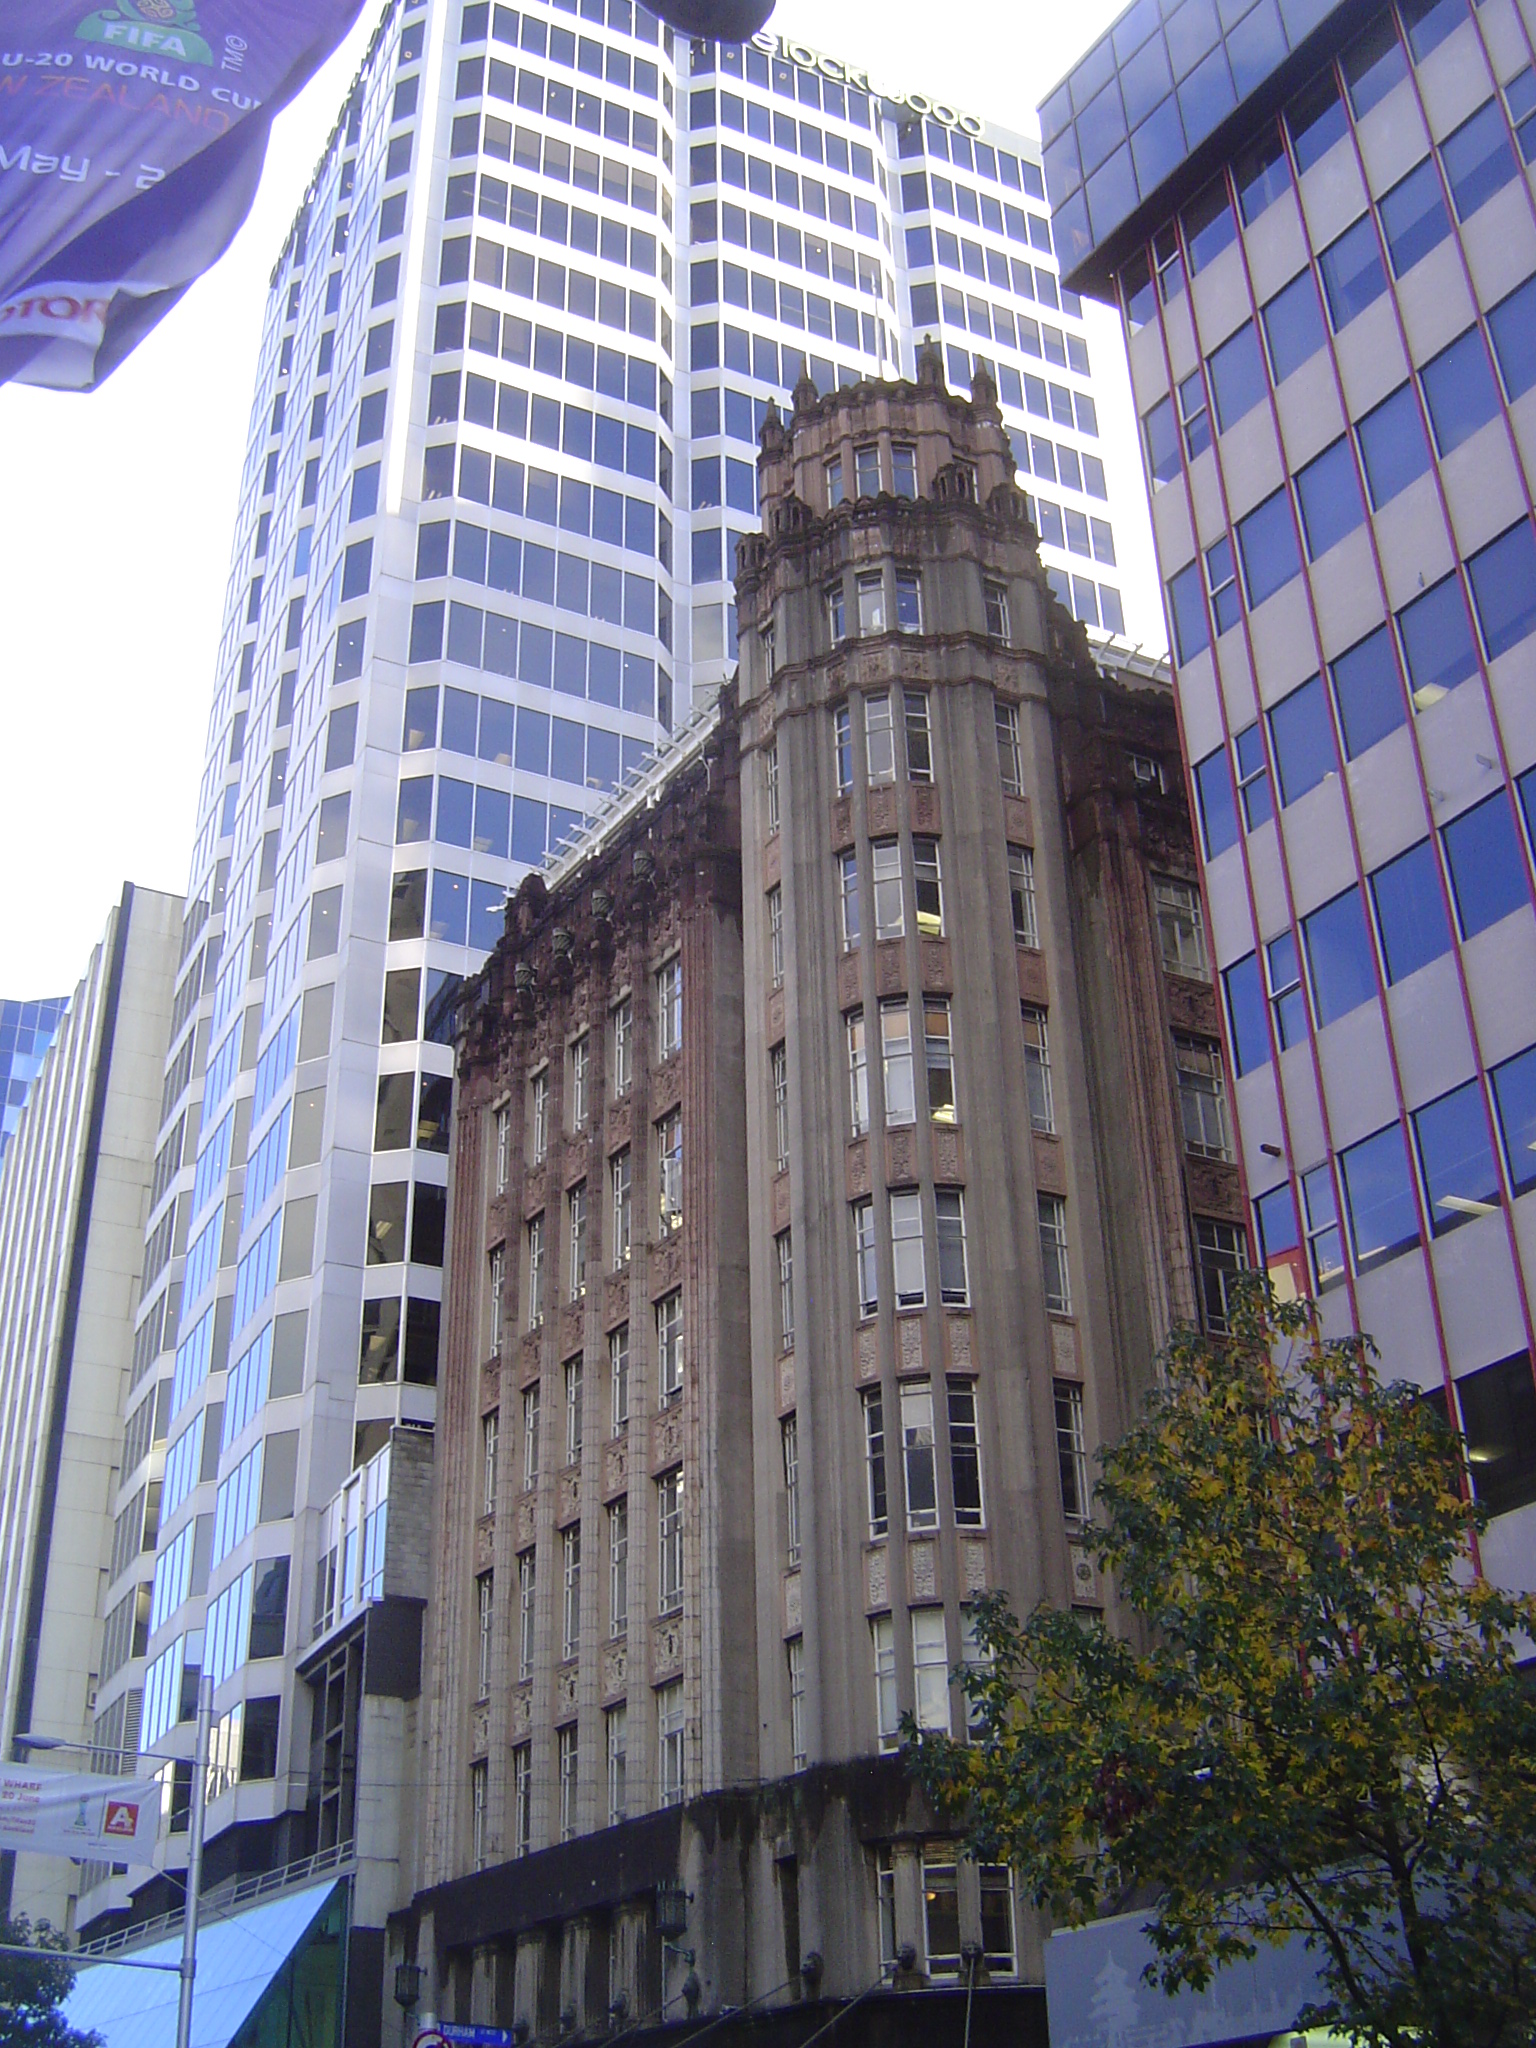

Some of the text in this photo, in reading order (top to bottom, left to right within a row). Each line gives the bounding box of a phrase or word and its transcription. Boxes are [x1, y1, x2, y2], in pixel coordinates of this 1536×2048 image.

[103, 22, 187, 57] FIFA
[2, 52, 73, 67] U-20
[85, 54, 200, 92] WORLD
[751, 29, 986, 137] elockwood
[34, 75, 230, 135] ZEALAND
[0, 144, 91, 182] May
[136, 163, 165, 190] 2
[4, 1779, 42, 1791] WHARF
[443, 2024, 476, 2038] DURHAM
